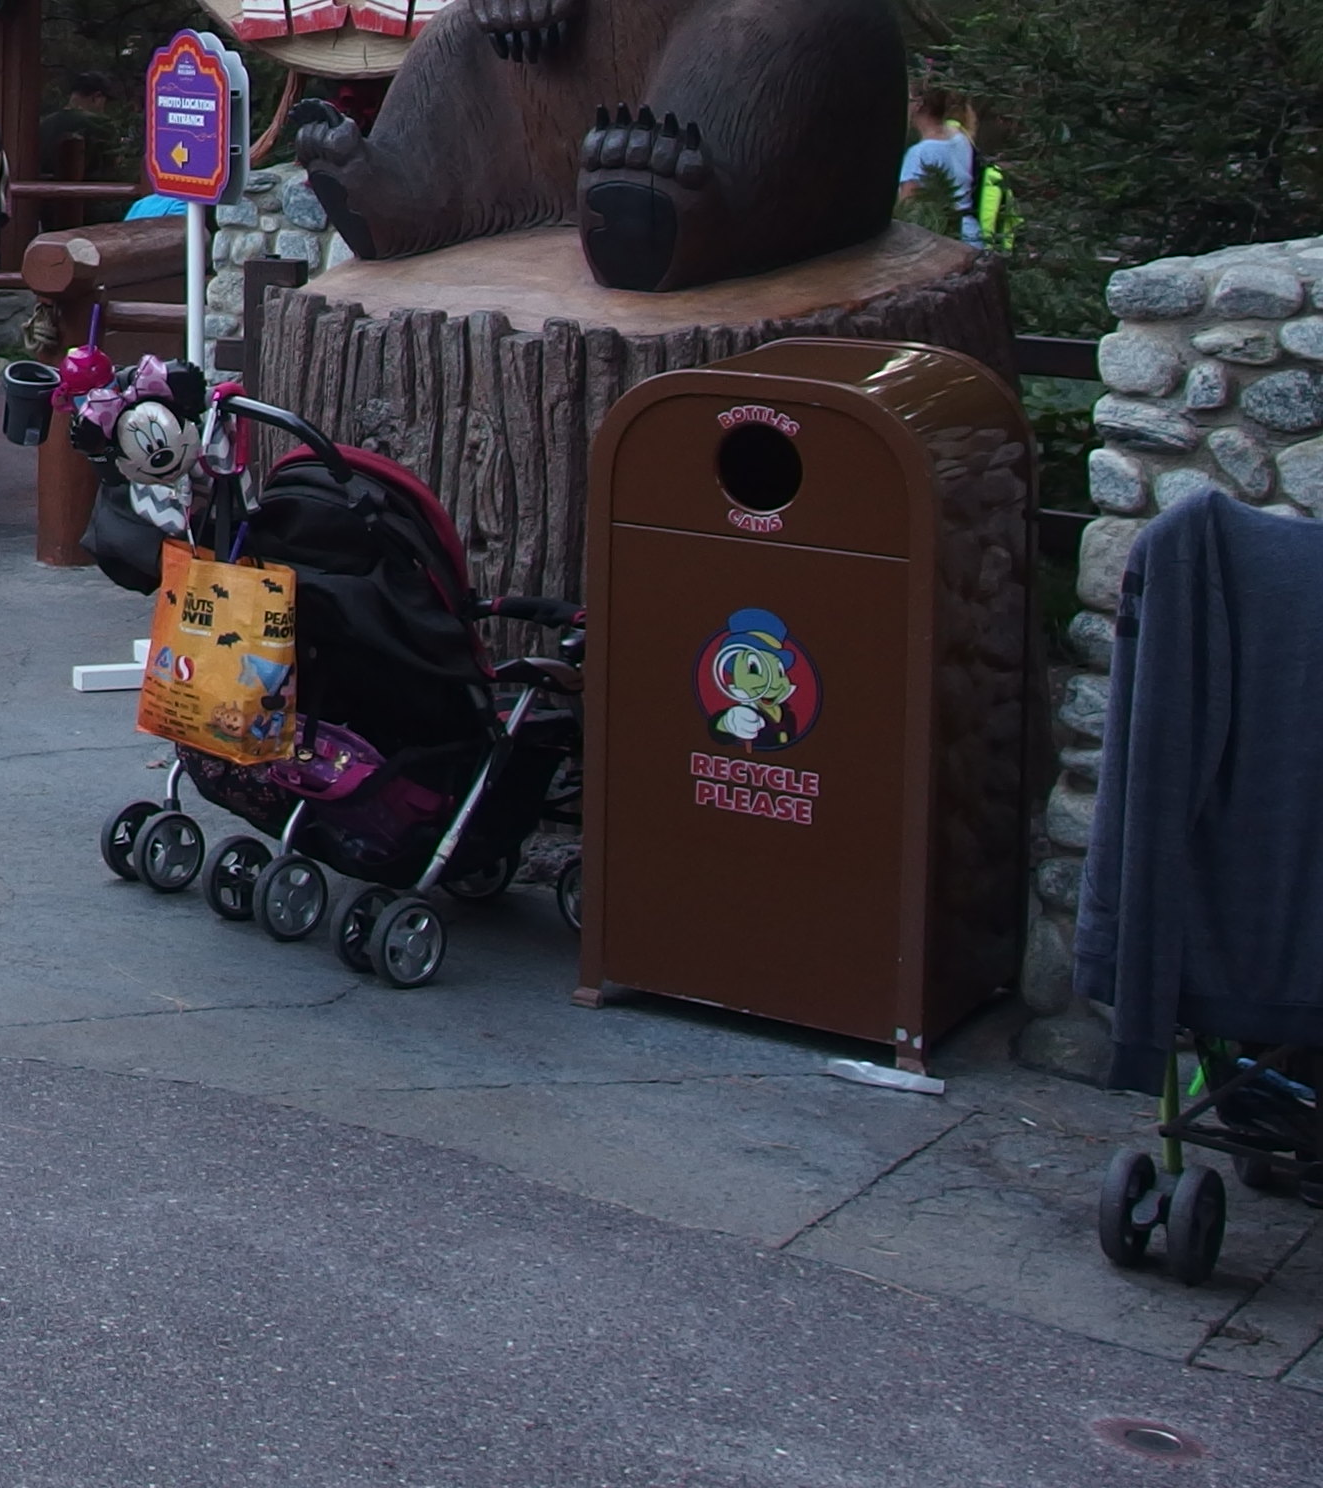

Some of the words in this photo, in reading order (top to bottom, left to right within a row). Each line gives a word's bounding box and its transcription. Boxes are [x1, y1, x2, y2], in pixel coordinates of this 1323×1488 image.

[158, 95, 181, 109] PHOTO
[181, 98, 216, 111] LOCATION
[168, 112, 205, 127] ENTRANCE
[717, 404, 801, 437] BOTTLES
[728, 509, 783, 532] CANS
[691, 752, 820, 797] RECYCLE
[696, 780, 813, 825] PLEASE
